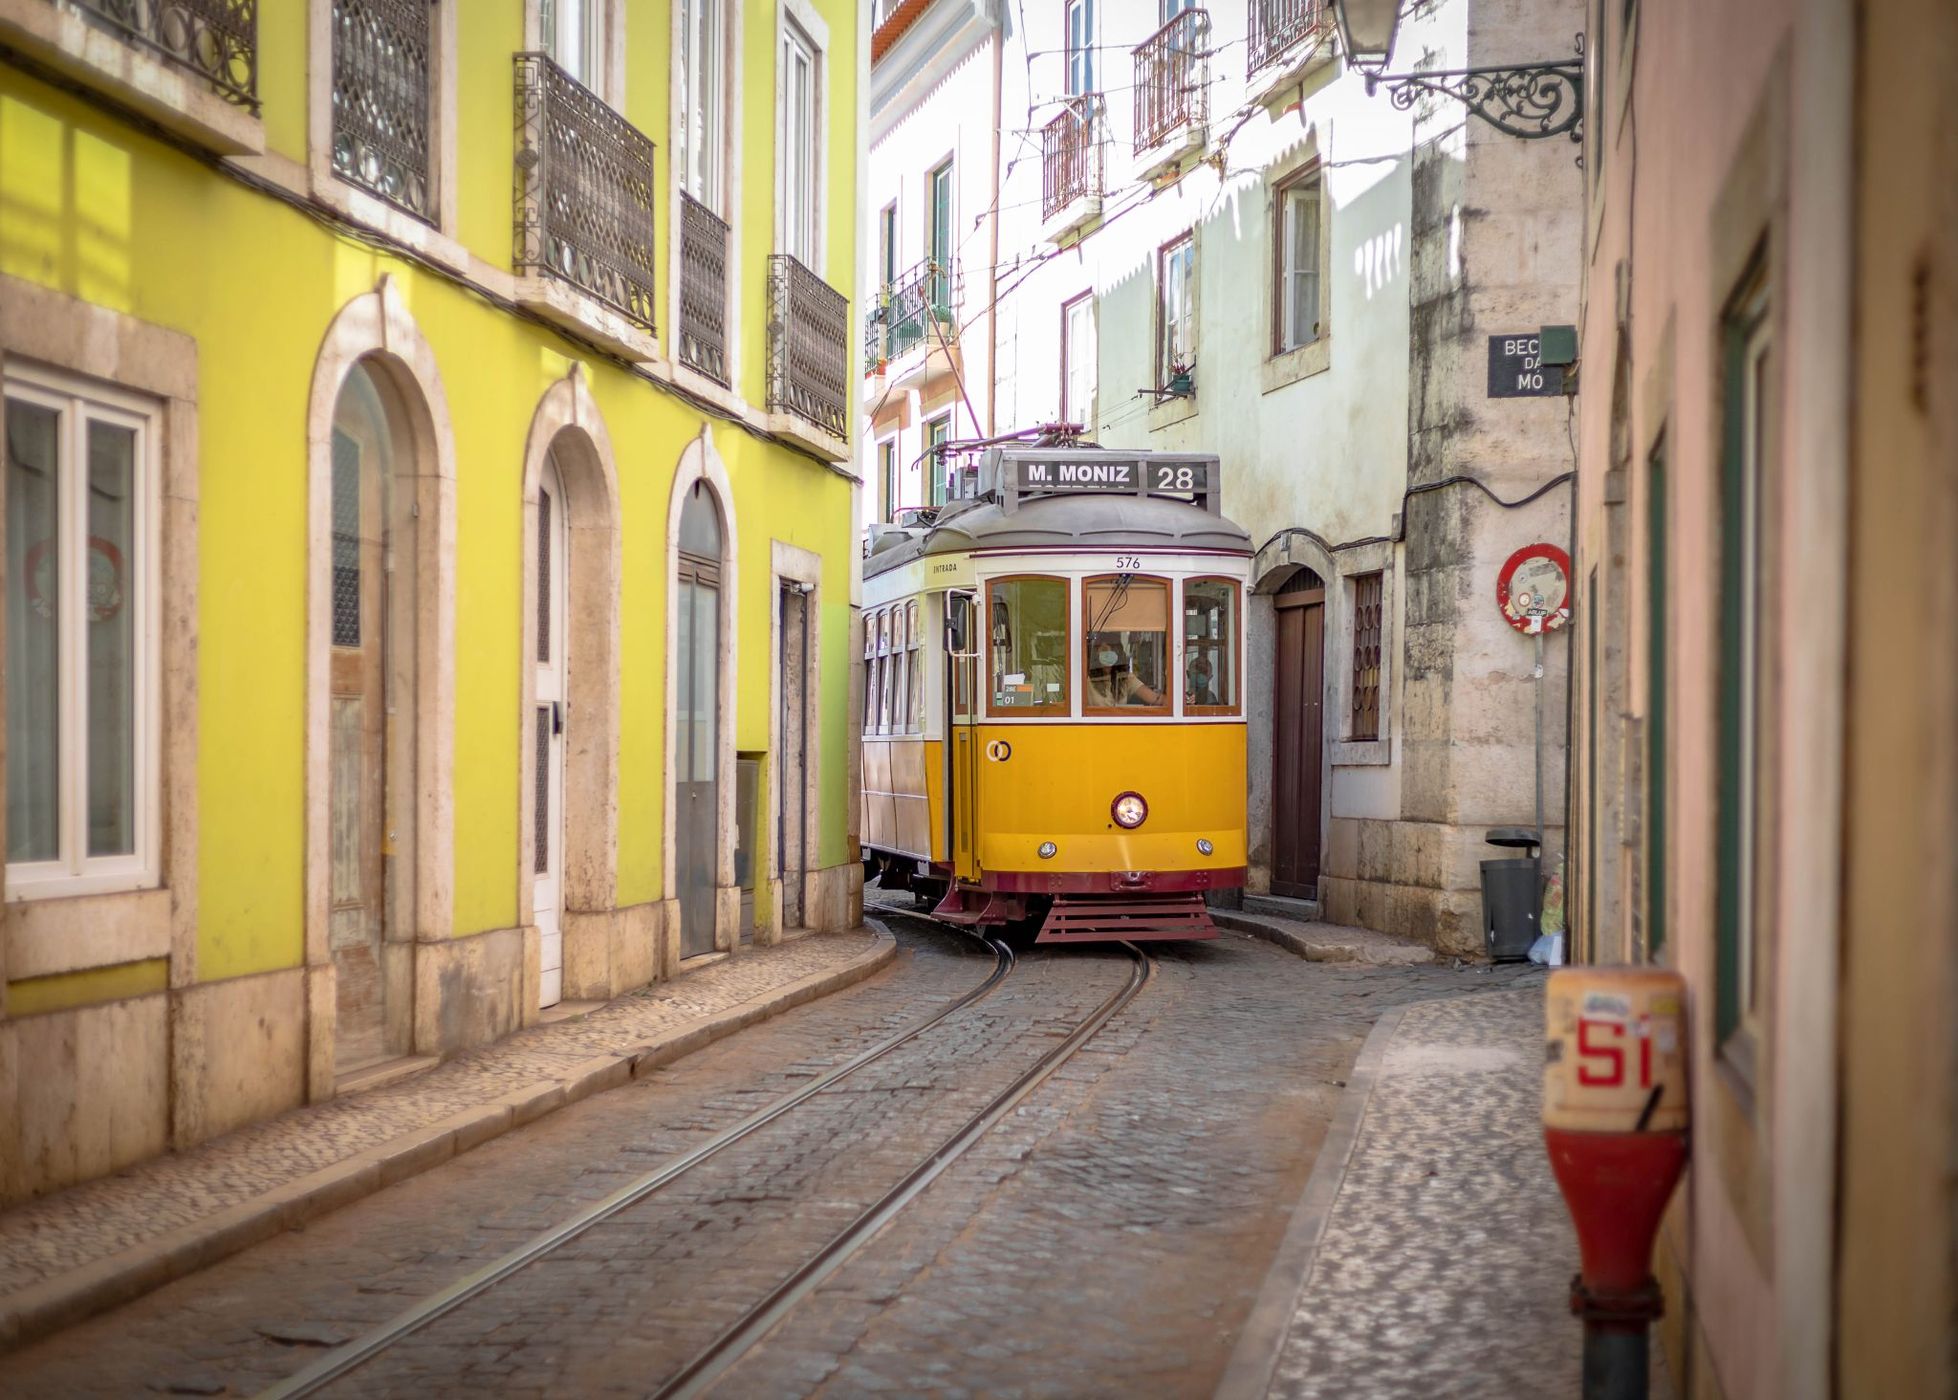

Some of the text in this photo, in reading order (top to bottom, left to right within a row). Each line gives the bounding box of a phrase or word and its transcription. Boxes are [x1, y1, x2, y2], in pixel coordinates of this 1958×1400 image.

[1505, 339, 1540, 355] BEC
[1518, 369, 1543, 389] MÓ
[1028, 465, 1130, 482] M. MONIZ
[1157, 467, 1193, 489] 28
[933, 563, 957, 574] ENTRADA
[1116, 557, 1141, 569] 576
[1004, 696, 1015, 704] 01
